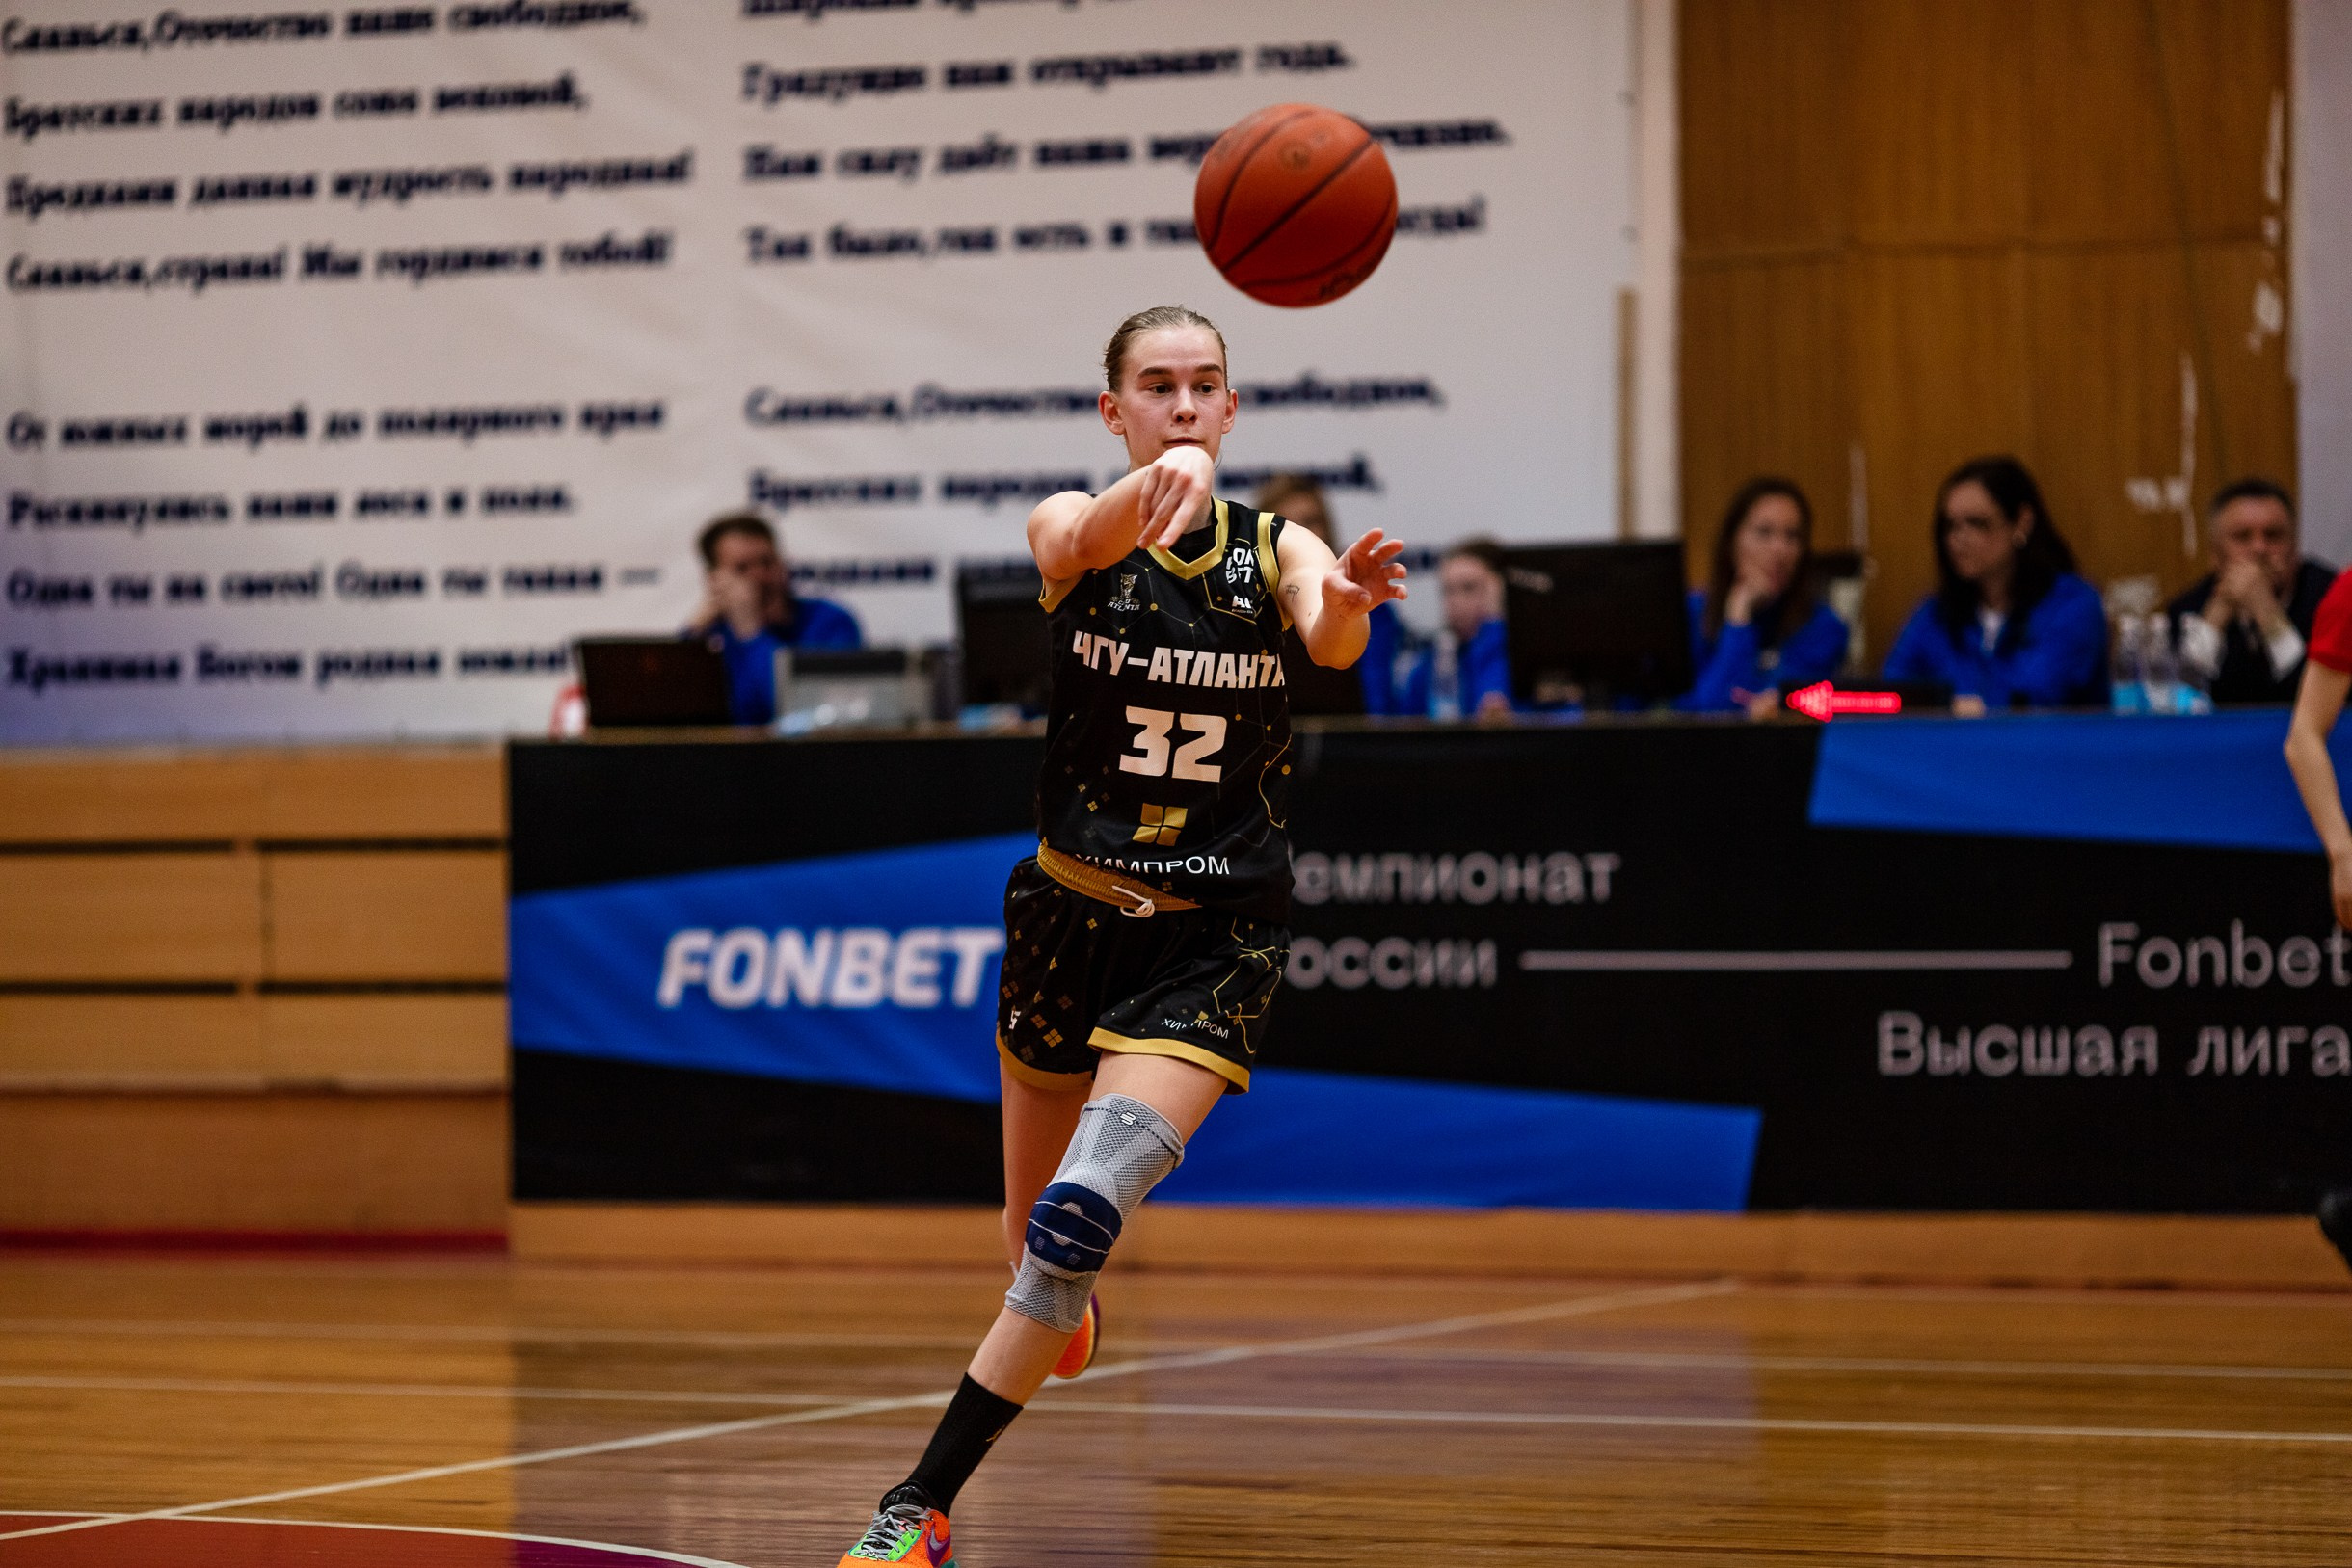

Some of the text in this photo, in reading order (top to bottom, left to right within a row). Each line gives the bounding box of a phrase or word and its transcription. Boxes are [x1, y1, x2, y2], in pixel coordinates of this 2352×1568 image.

[1118, 705, 1228, 783] 32
[1291, 851, 1621, 906] емпионат
[658, 927, 1005, 1009] FONBET
[1285, 935, 1498, 991] оссии
[1877, 1009, 2159, 1077] Высшая
